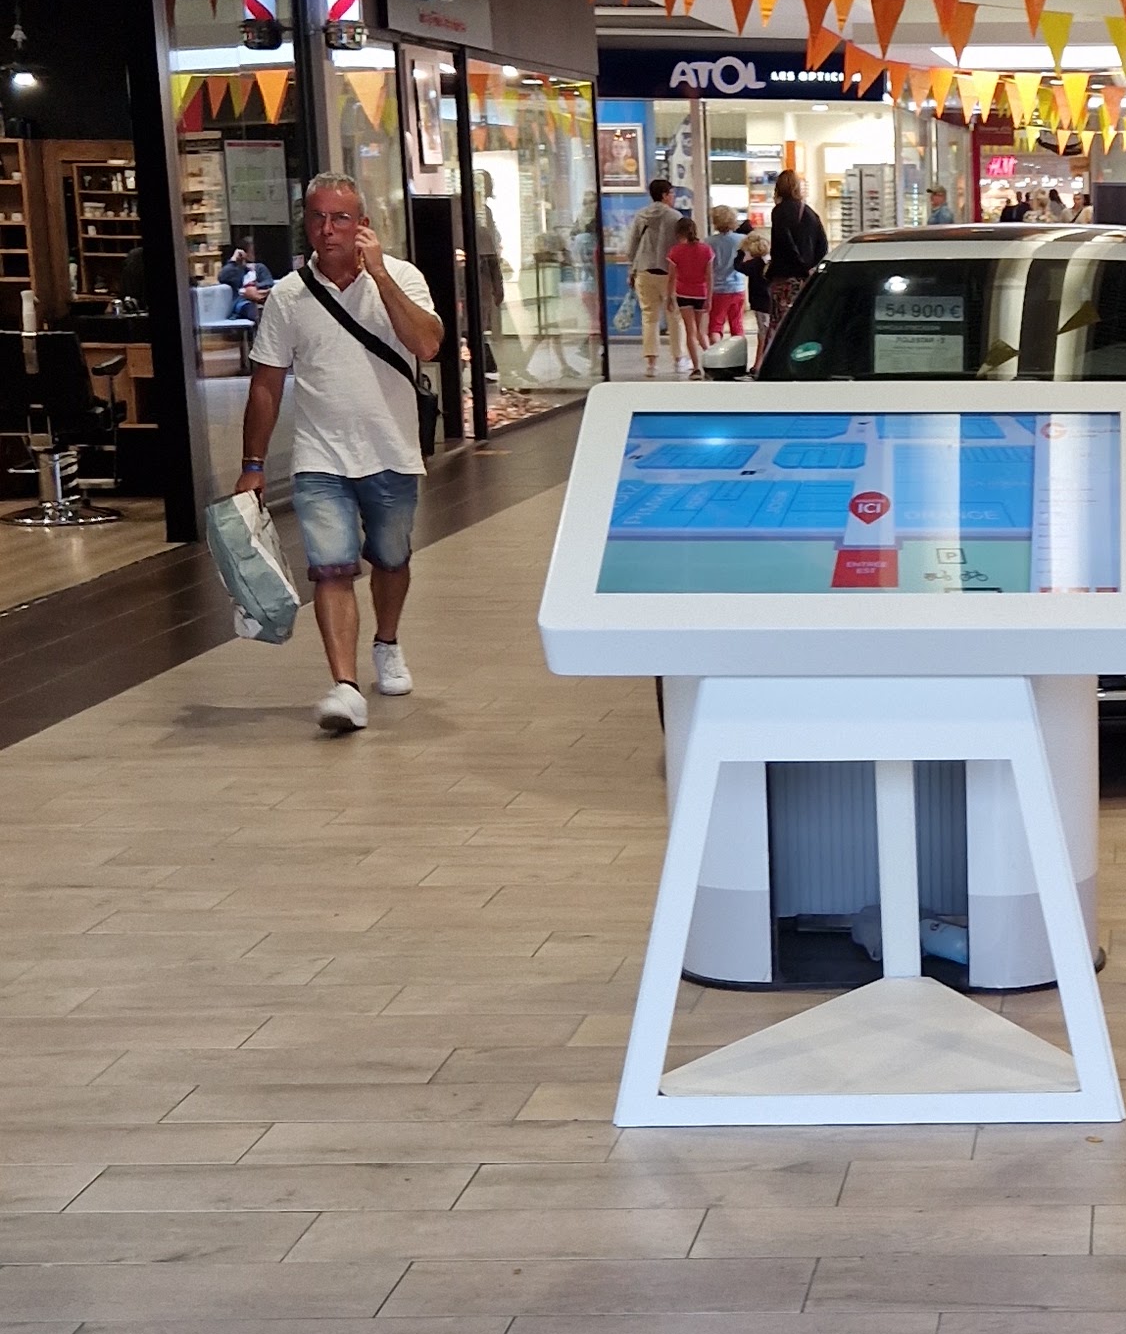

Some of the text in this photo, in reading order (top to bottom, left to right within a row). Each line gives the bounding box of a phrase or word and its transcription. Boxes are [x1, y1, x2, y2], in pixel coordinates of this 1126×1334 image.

[669, 56, 766, 94] ATOL
[770, 71, 795, 82] LES
[885, 303, 962, 319] 54 900 €
[857, 502, 882, 515] ICI
